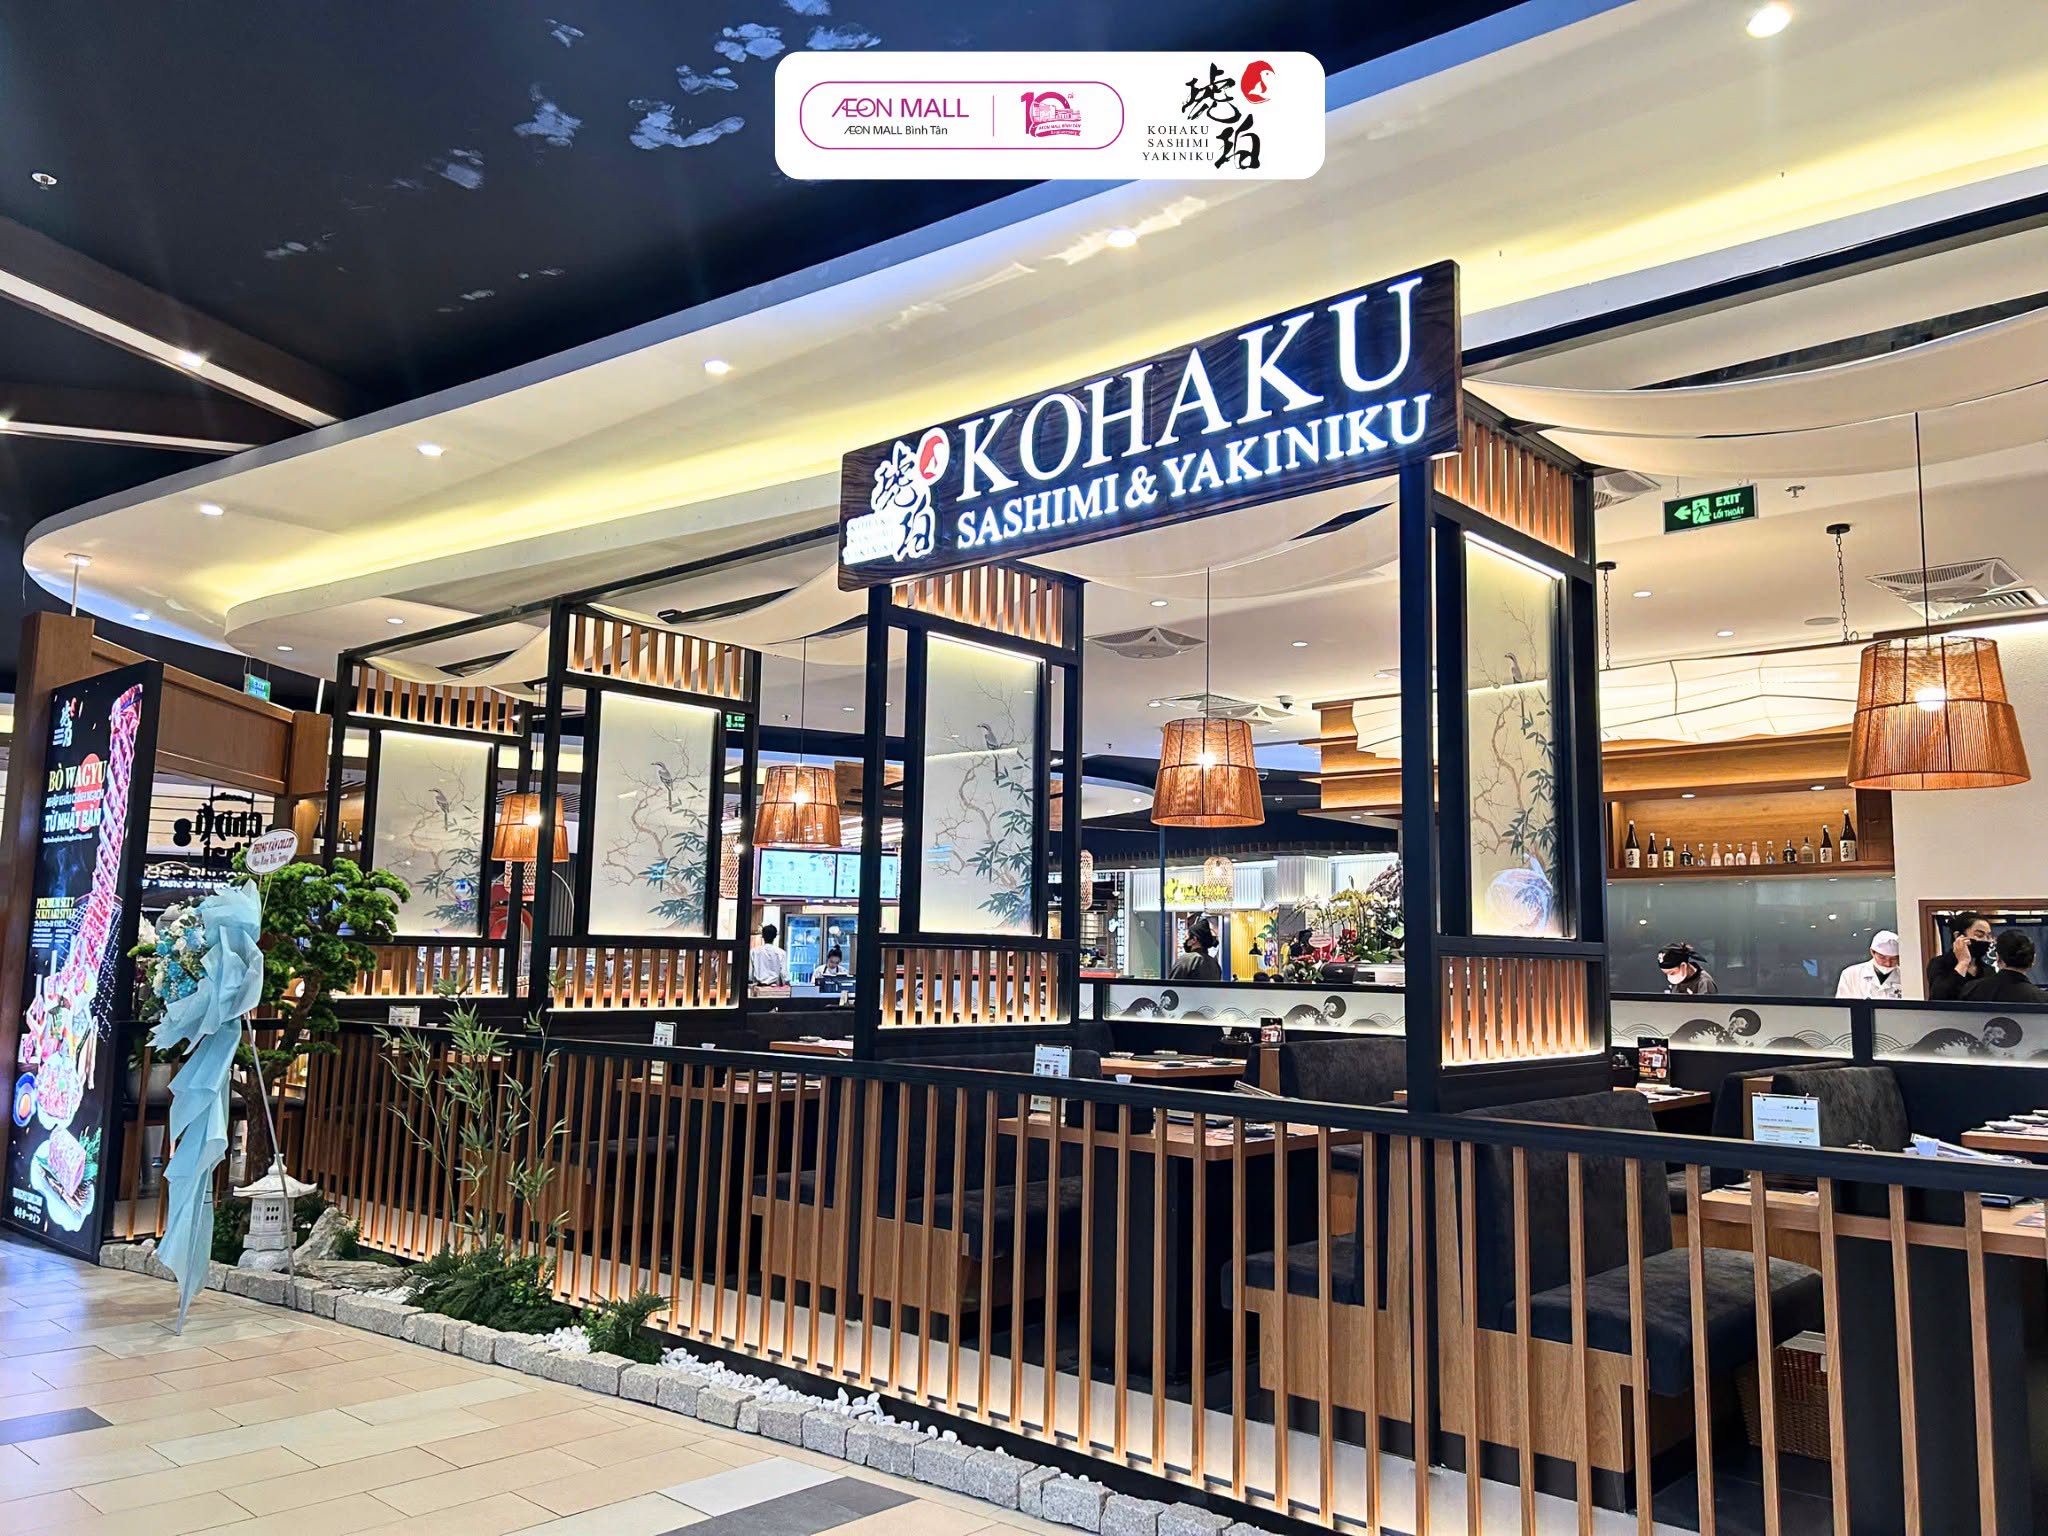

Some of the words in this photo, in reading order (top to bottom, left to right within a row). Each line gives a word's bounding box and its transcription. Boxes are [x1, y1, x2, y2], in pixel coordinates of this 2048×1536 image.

[956, 277, 1423, 503] KOHAKU
[957, 477, 1119, 549] SASHIMI
[1126, 465, 1158, 509] &
[1164, 394, 1432, 497] YAKINIKU
[1716, 493, 1741, 507] EXIT
[48, 763, 64, 792] BÒ
[65, 761, 107, 789] WAGYU
